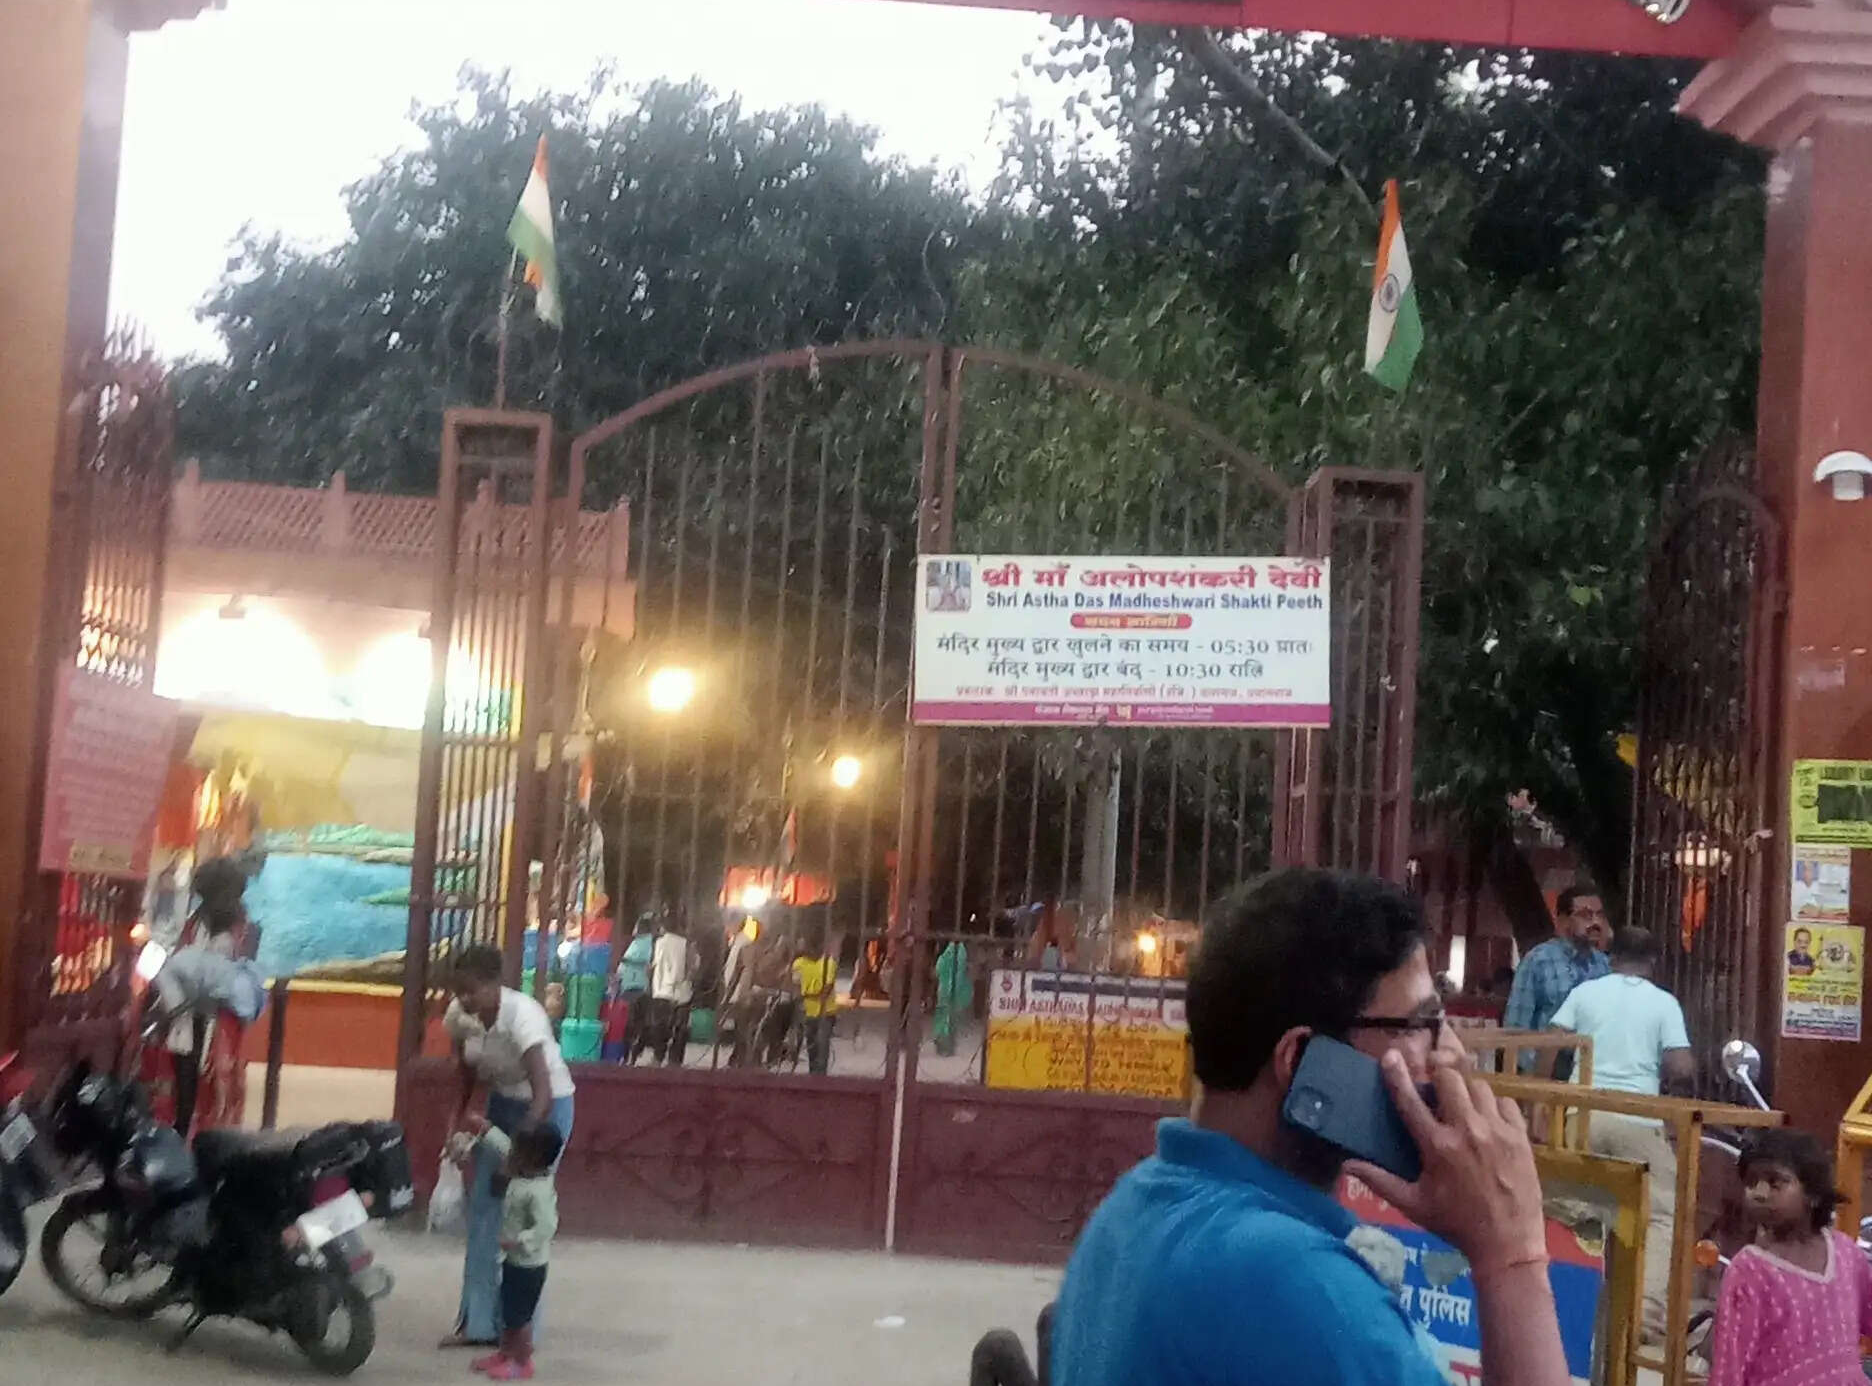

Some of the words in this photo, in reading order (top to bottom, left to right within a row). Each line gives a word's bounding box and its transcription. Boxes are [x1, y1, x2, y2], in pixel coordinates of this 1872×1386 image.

[981, 562, 1022, 587] श्री
[1268, 561, 1323, 590] देवी
[986, 592, 1017, 608] Shri
[1022, 592, 1069, 608] Astha
[1074, 592, 1104, 608] Das
[1109, 592, 1215, 609] Madheshwari
[1220, 593, 1272, 609] Shakti
[1277, 594, 1323, 610] Peeth
[937, 632, 979, 655] मंदिर
[986, 636, 1024, 658] मुख्य
[1031, 637, 1058, 654] द्वार
[1066, 633, 1112, 658] खुलने
[1119, 638, 1141, 654] का
[1147, 638, 1189, 654] समय
[1211, 640, 1269, 655] 05:30
[987, 656, 1028, 679] मंदिर
[1036, 662, 1074, 682] मुख्य
[1082, 662, 1109, 679] द्वार
[1166, 663, 1221, 678] 10:30
[1420, 1285, 1471, 1326] पुलिस
